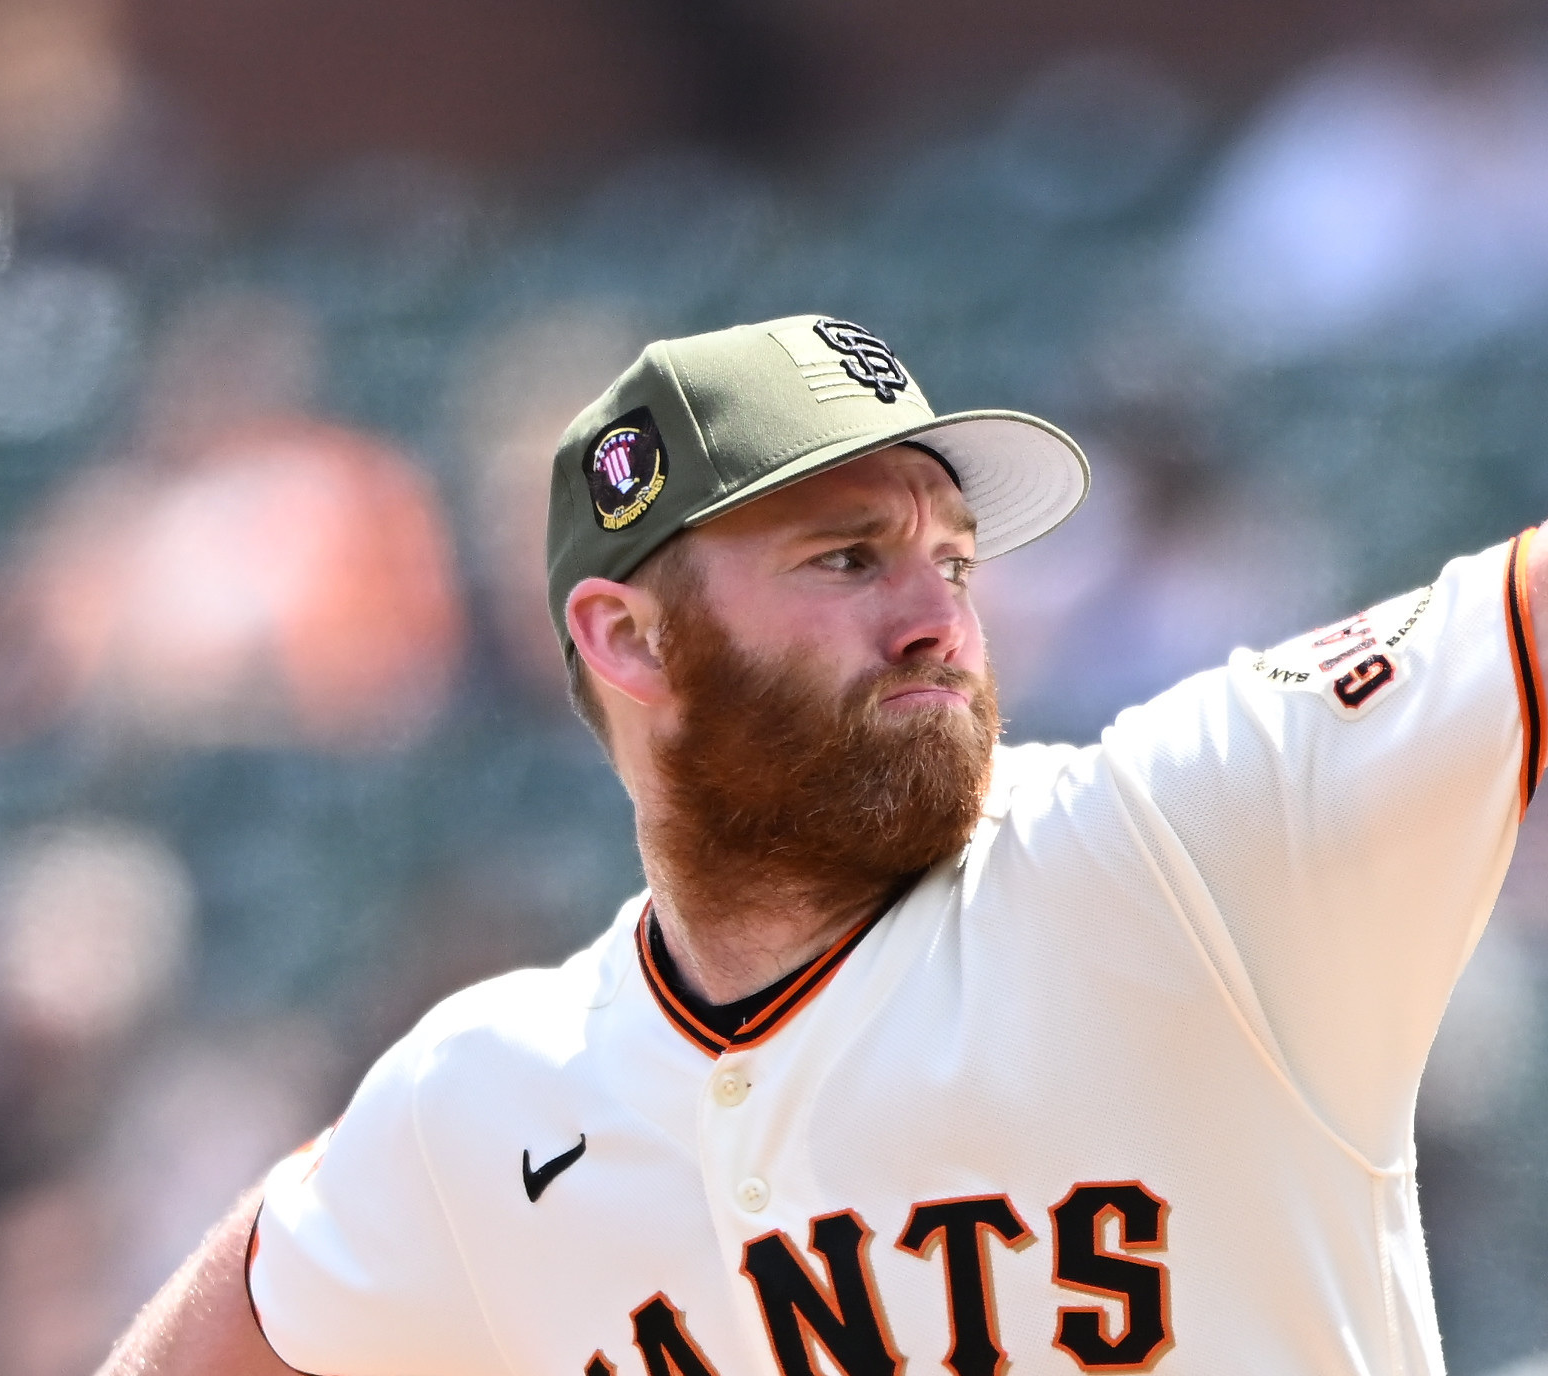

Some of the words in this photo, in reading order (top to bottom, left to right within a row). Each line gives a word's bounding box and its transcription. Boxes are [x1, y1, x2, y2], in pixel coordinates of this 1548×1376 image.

[813, 319, 908, 403] SF
[603, 515, 616, 530] OUR
[616, 502, 648, 530] NATION'S
[645, 474, 666, 504] FINEST
